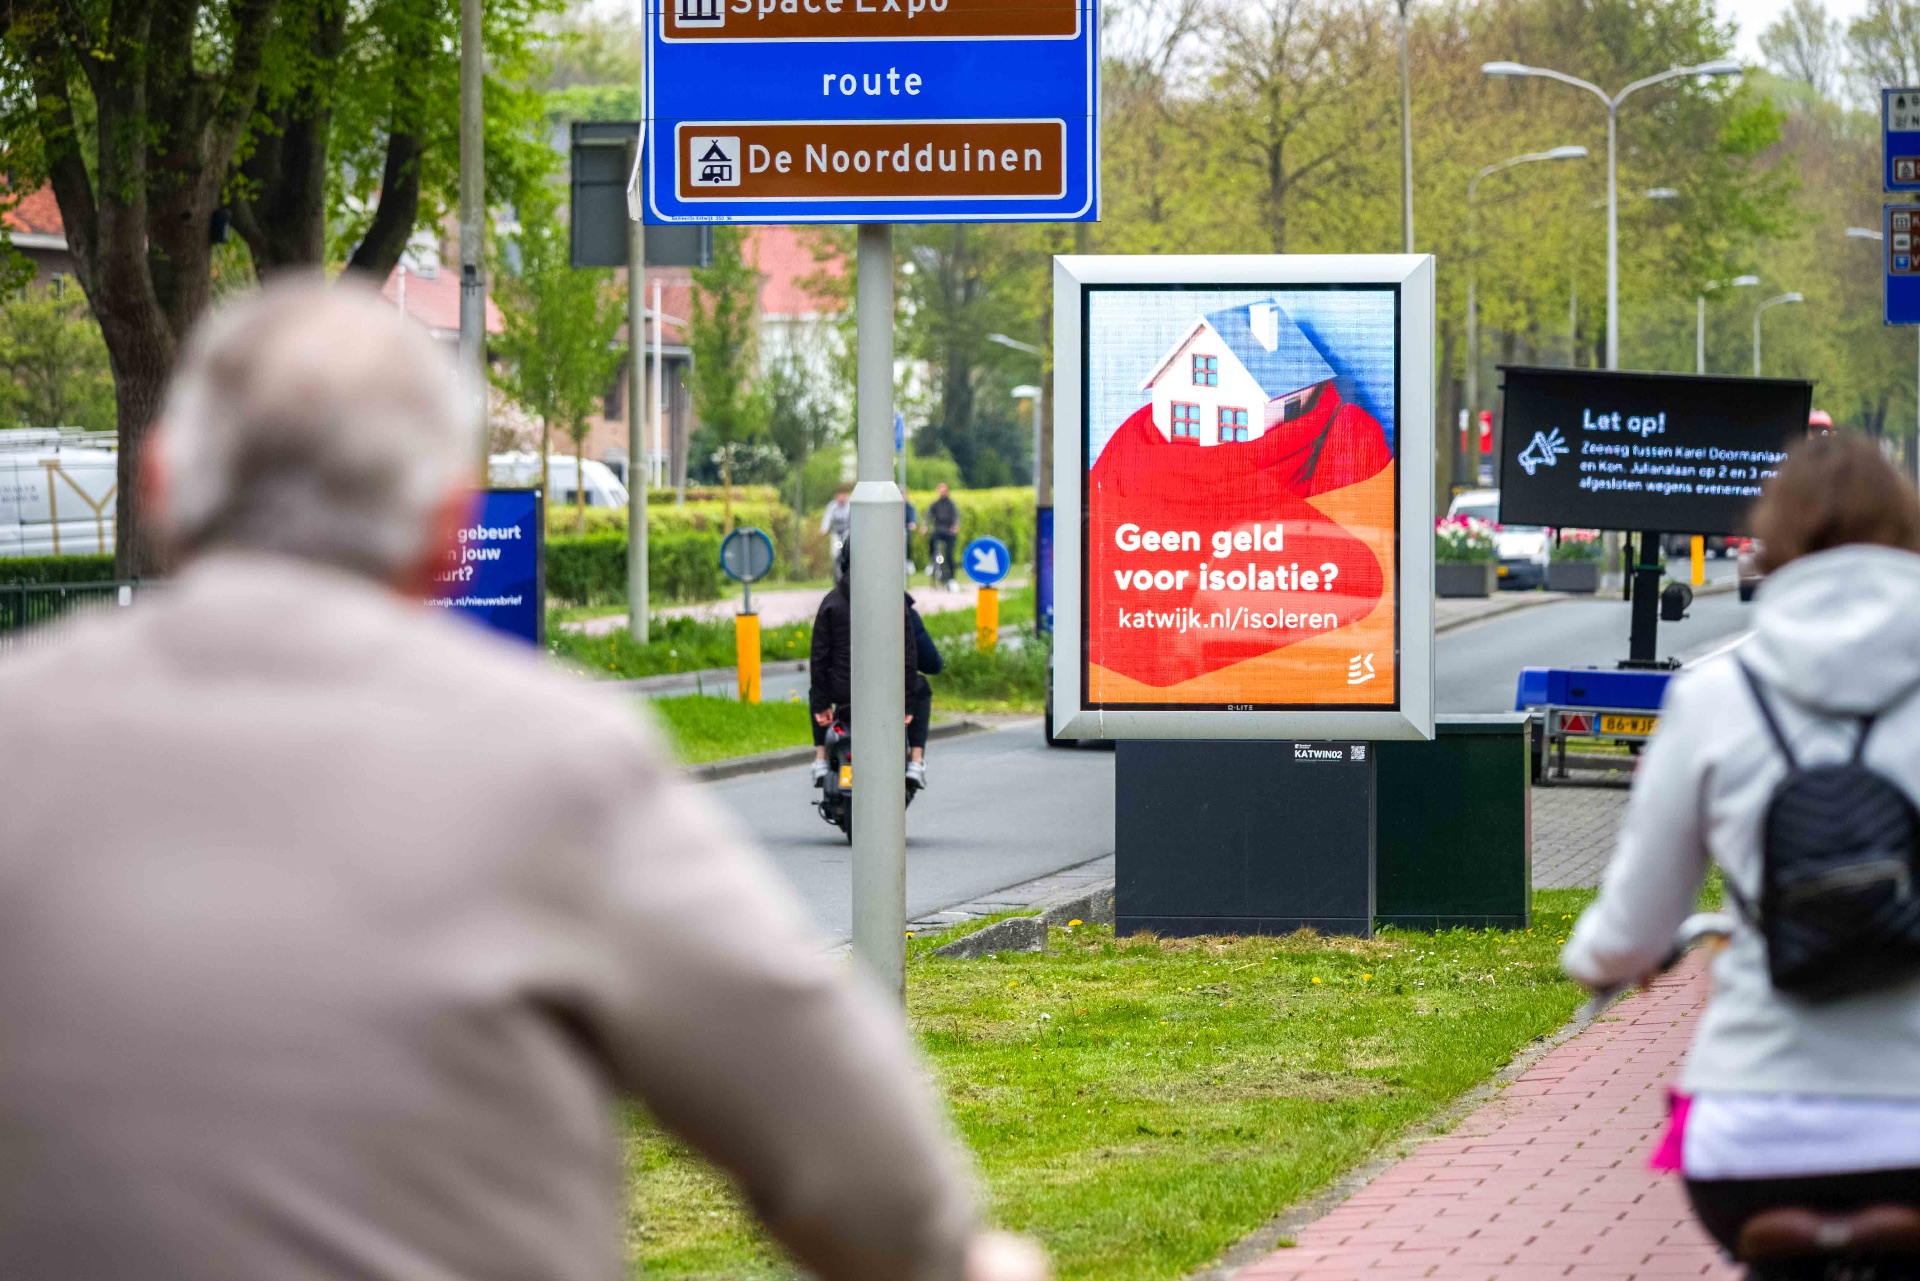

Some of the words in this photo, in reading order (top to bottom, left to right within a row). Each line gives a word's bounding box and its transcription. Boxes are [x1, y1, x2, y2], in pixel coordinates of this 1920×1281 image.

[822, 66, 923, 96] route
[748, 144, 793, 174] De
[805, 142, 1043, 173] Noordduinen
[1582, 408, 1622, 431] Let
[1626, 411, 1667, 437] op!
[1632, 444, 1673, 458] tussen
[1675, 445, 1707, 460] Karel
[1579, 461, 1597, 472] en
[1698, 467, 1716, 480] op
[1718, 464, 1728, 479] 2
[1730, 468, 1747, 480] en
[1748, 466, 1758, 480] 3
[457, 524, 522, 544] gebeurt
[1115, 523, 1200, 552] Geen
[1211, 523, 1284, 557] geld
[461, 545, 502, 564] jouw
[1114, 567, 1190, 591] voor
[1200, 562, 1339, 591] isolatie?
[1118, 607, 1339, 633] katwijk.nl/isoleren
[1294, 749, 1343, 759] KATWIN02
